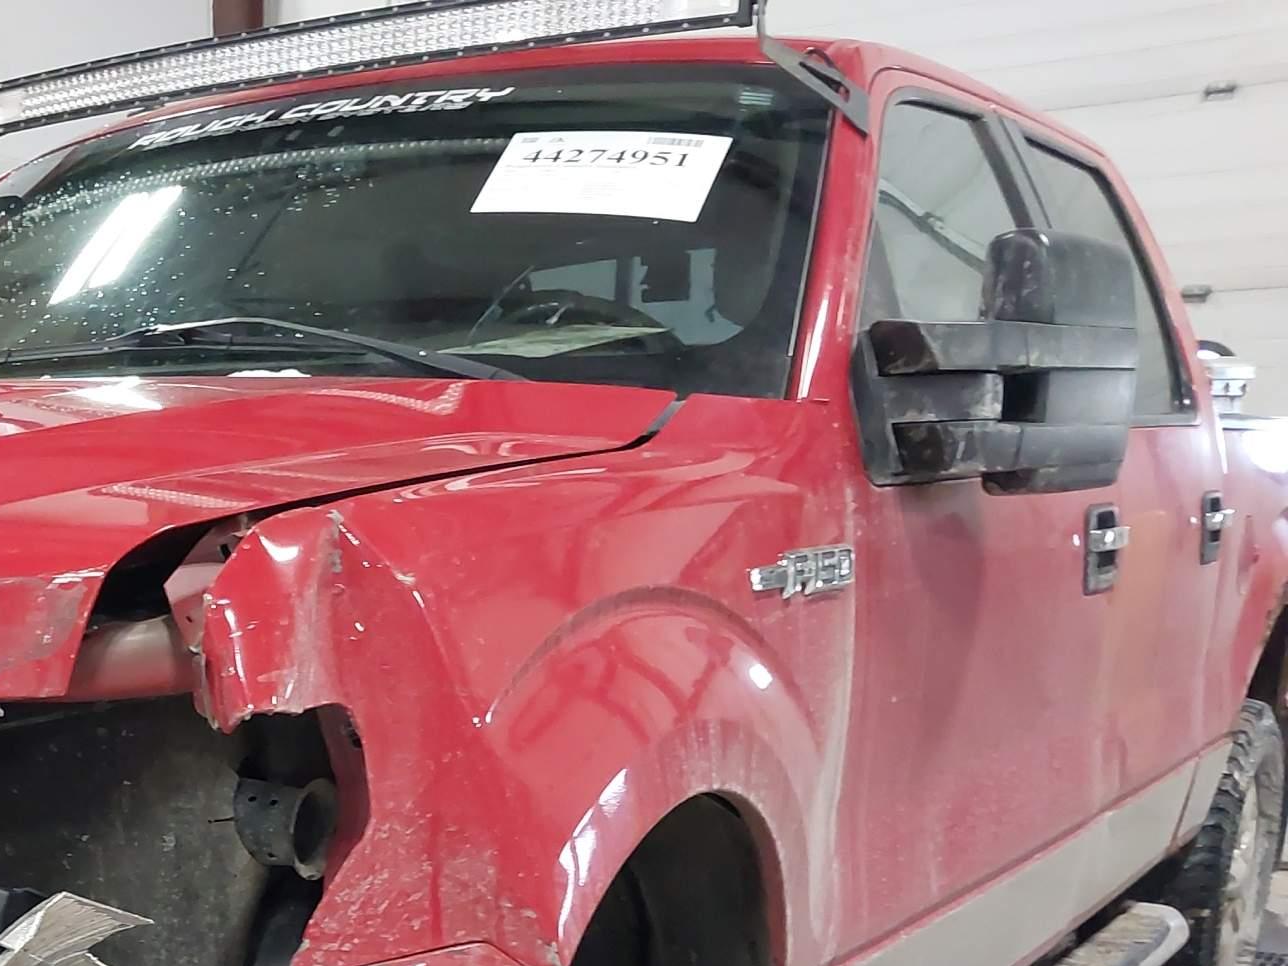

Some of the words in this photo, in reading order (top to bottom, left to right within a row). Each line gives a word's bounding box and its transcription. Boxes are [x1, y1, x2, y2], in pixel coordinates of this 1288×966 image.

[127, 108, 276, 150] ROUGH
[279, 86, 517, 120] COUNTRY
[523, 148, 689, 168] 44274951
